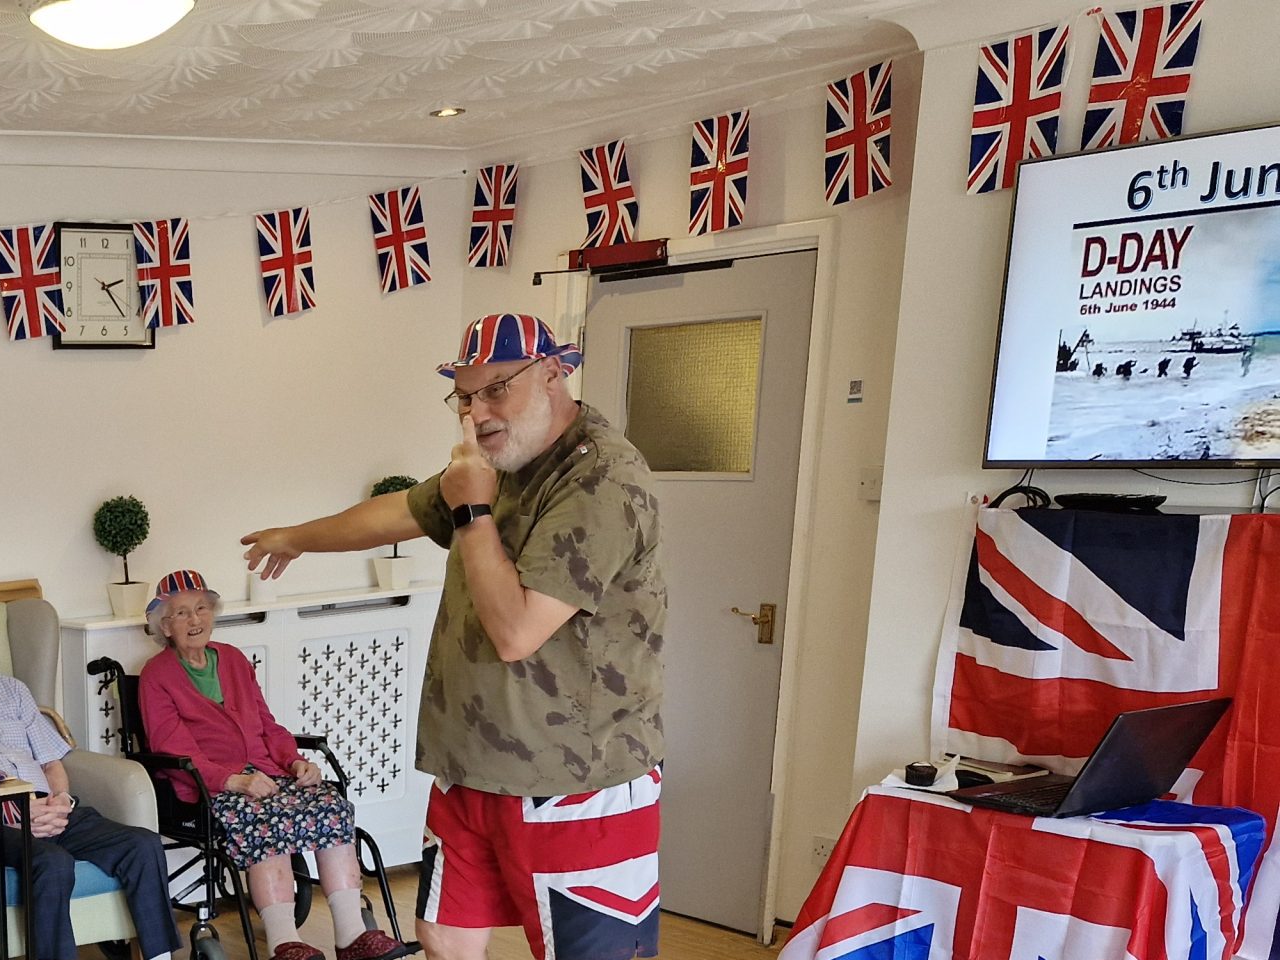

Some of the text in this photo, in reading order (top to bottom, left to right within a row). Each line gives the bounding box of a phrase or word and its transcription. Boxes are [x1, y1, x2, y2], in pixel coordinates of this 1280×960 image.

[1126, 159, 1190, 211] 6th
[80, 238, 87, 248] 11
[101, 238, 109, 249] 12
[1080, 225, 1195, 278] D-DAY
[64, 256, 75, 266] 10
[66, 281, 72, 292] 9
[1079, 275, 1183, 300] LANDINGS
[65, 307, 72, 317] 8
[1079, 297, 1177, 316] 6th June 1944
[79, 325, 128, 336] 7 6 5
